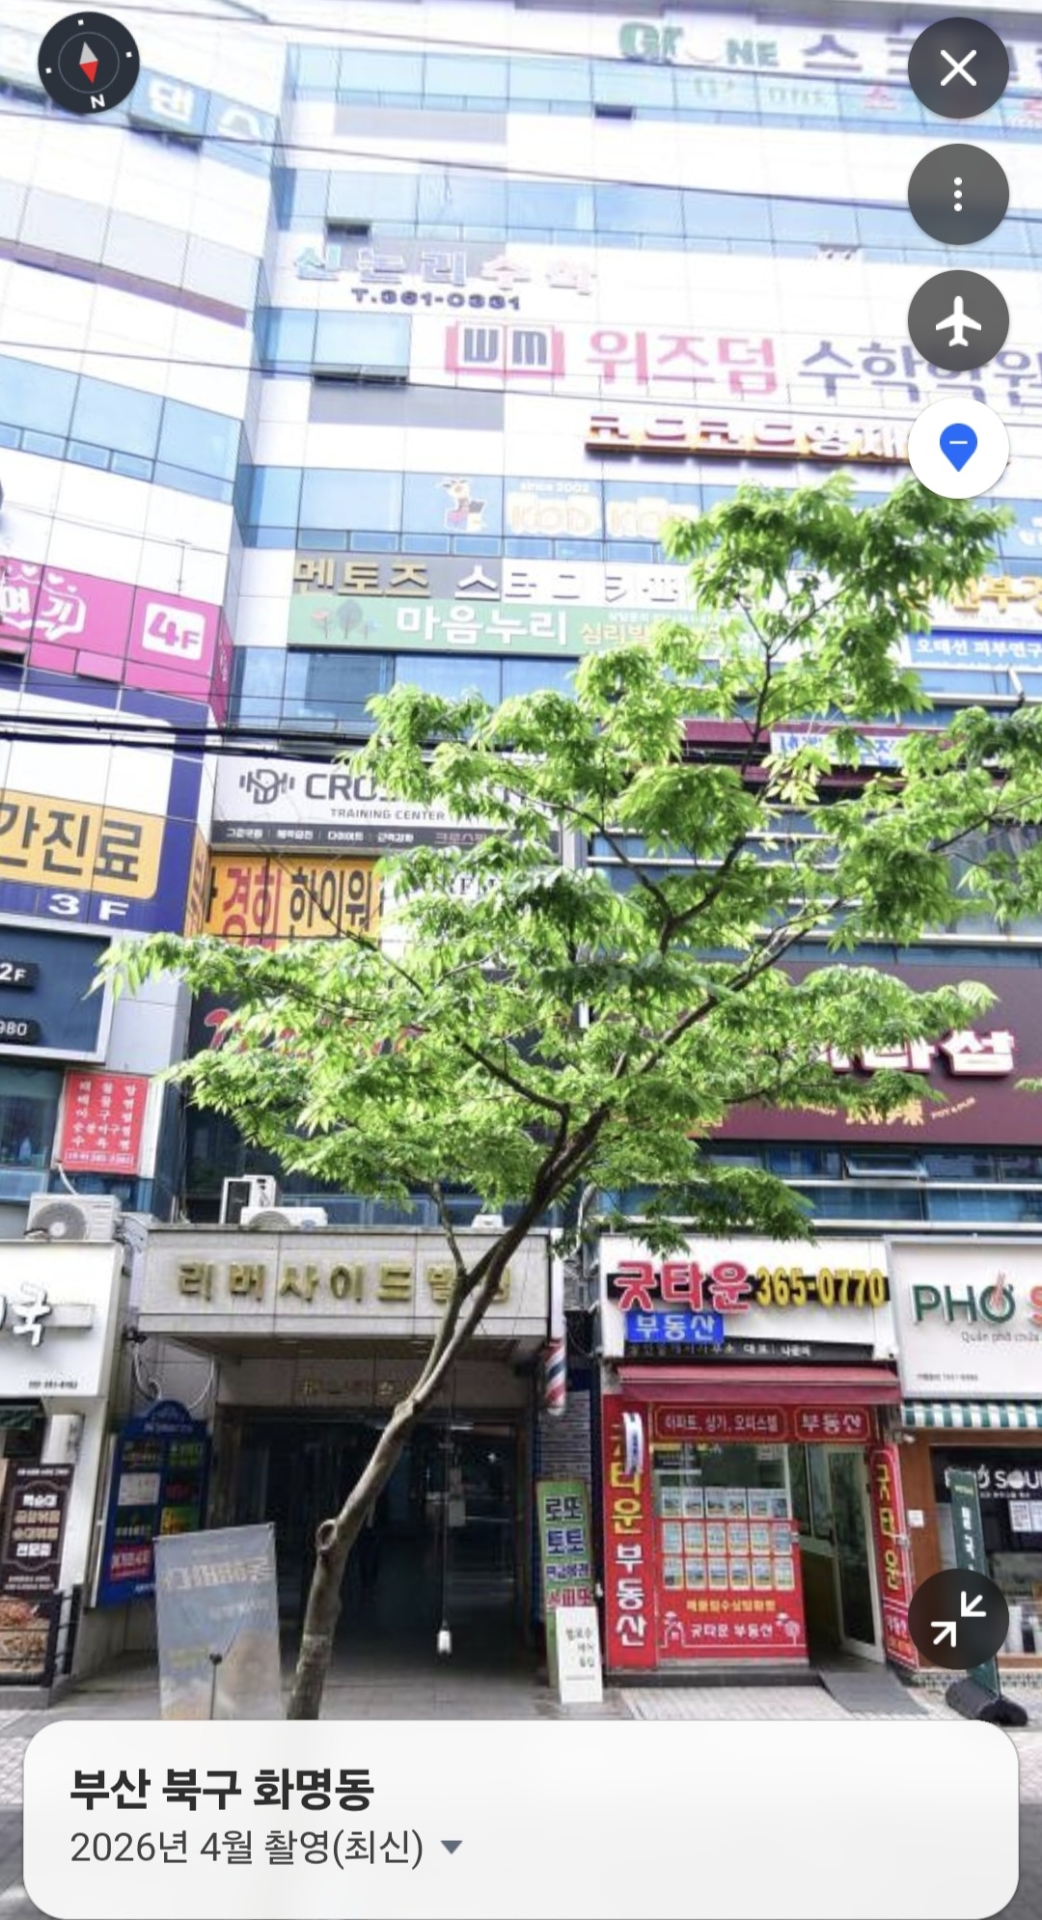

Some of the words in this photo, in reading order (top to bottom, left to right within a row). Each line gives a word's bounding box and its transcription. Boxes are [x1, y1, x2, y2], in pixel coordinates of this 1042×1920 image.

[585, 329, 778, 394] 위즈덤
[293, 558, 431, 598] 멘토즈
[148, 612, 200, 649] 4F
[396, 604, 566, 646] 마음누리
[331, 808, 392, 821] TRAINING
[394, 809, 445, 822] CENTER
[178, 1262, 511, 1302] 리버사이드빌
[613, 1260, 753, 1315] 굿타운
[757, 1268, 887, 1308] 365-0770
[635, 1315, 716, 1341] 부동산
[801, 1414, 862, 1433] 부동산
[545, 1494, 583, 1522] 로또
[547, 1528, 584, 1555] 토토
[615, 1543, 648, 1647] 부동산
[734, 1623, 772, 1638] 부동산
